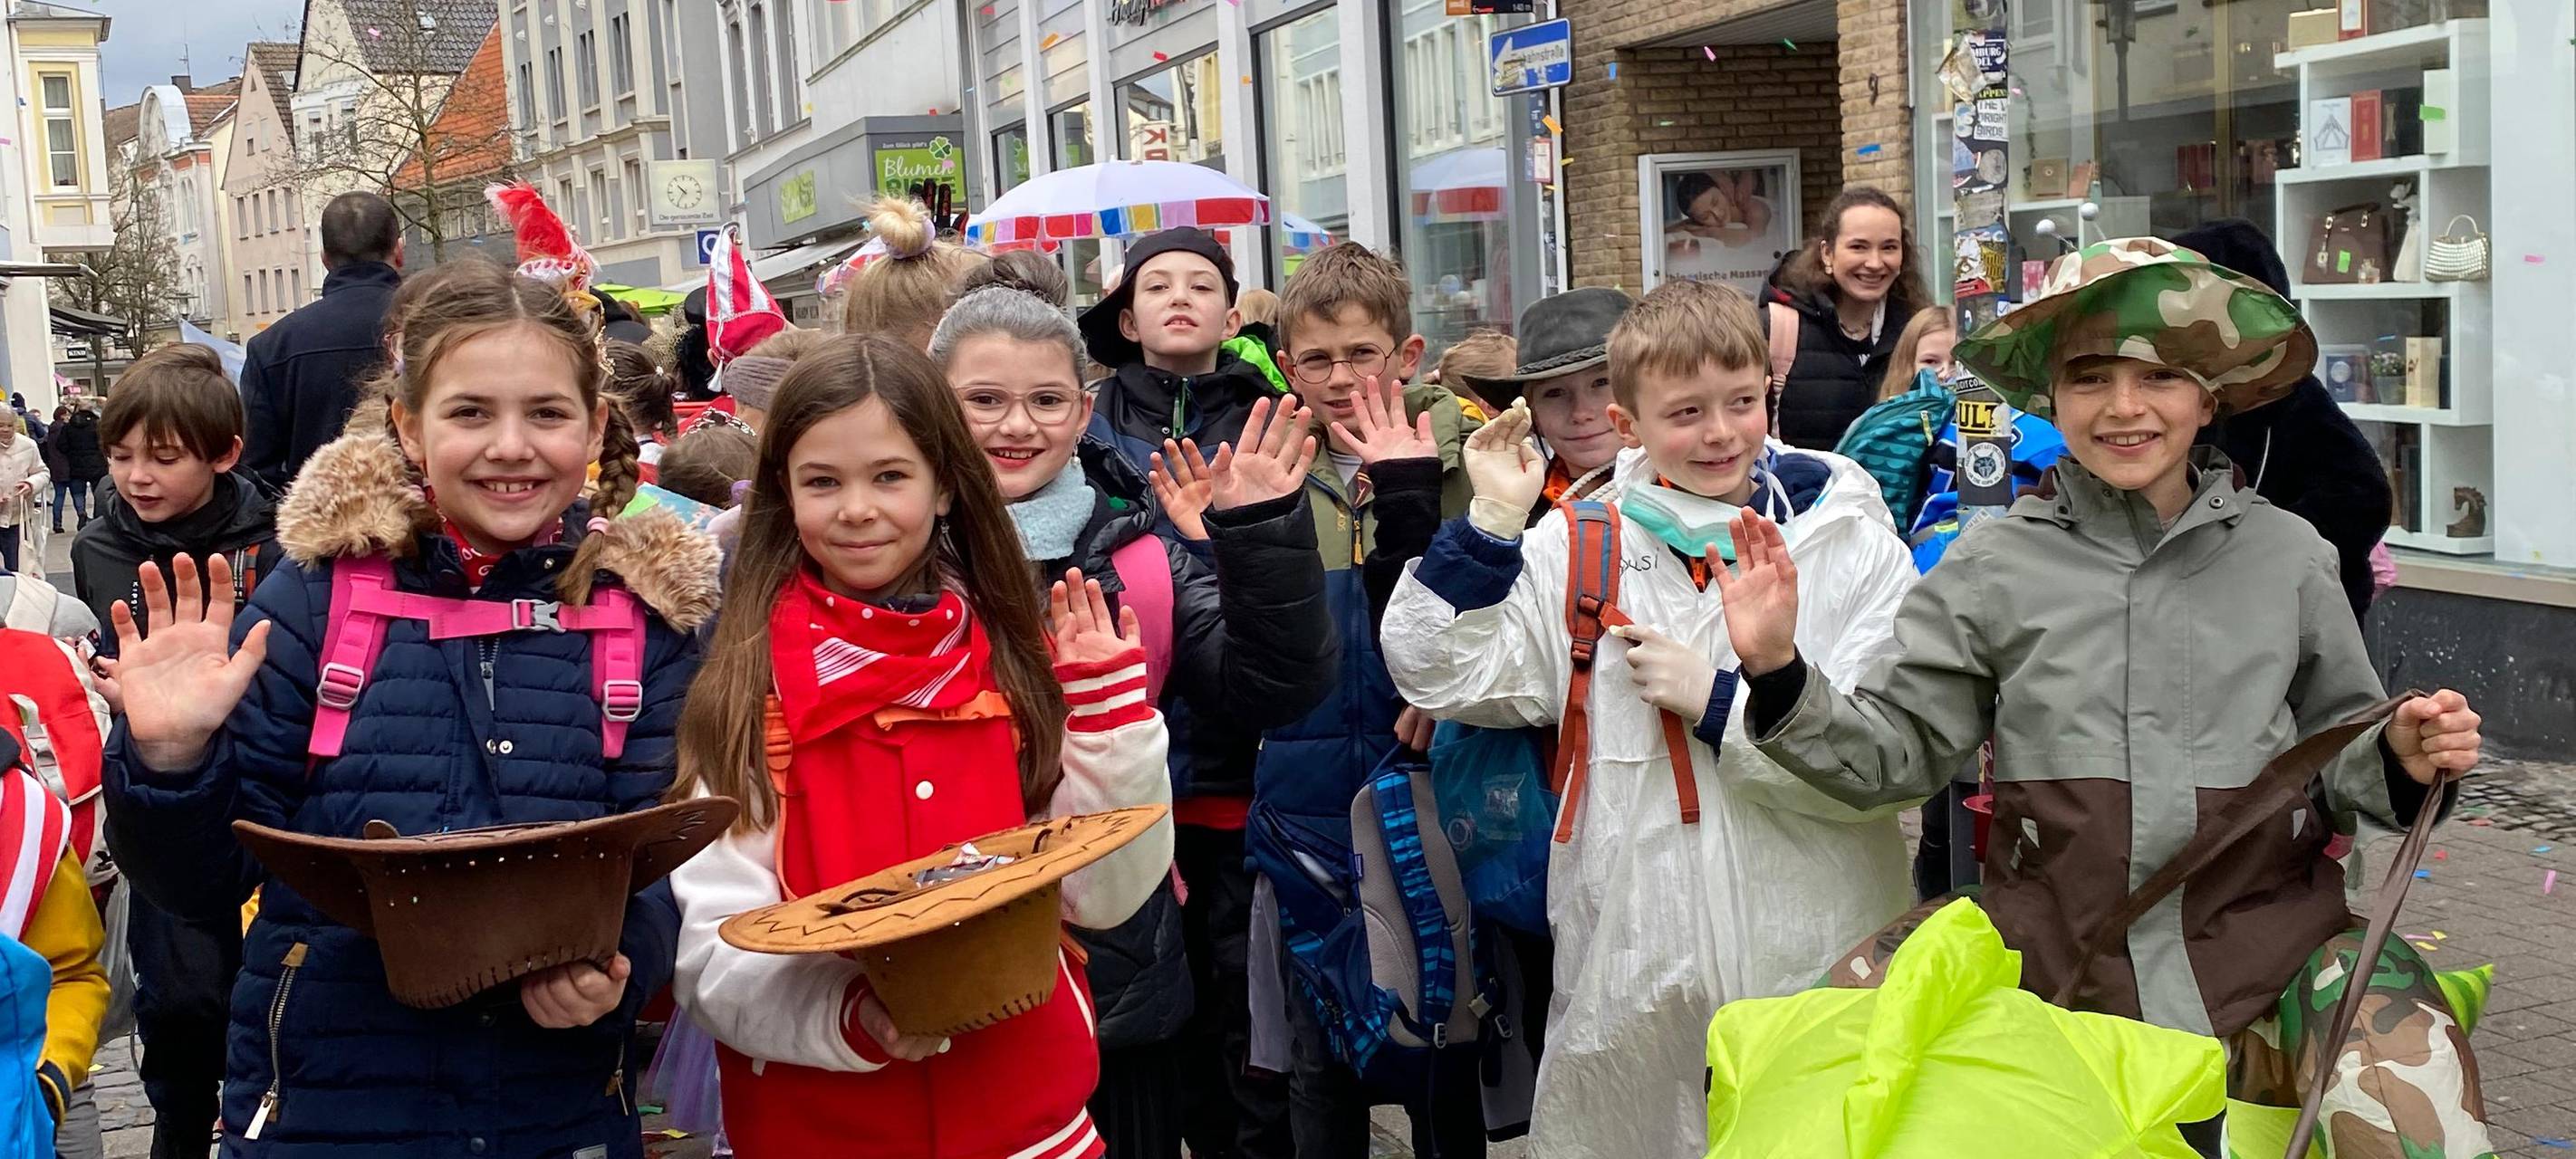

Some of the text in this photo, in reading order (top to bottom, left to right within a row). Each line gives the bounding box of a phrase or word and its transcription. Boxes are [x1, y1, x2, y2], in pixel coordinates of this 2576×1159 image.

[1511, 44, 1564, 65] bahnstraße
[1869, 72, 1879, 106] 9
[884, 156, 954, 177] Blumen
[1730, 269, 1769, 280] Massag
